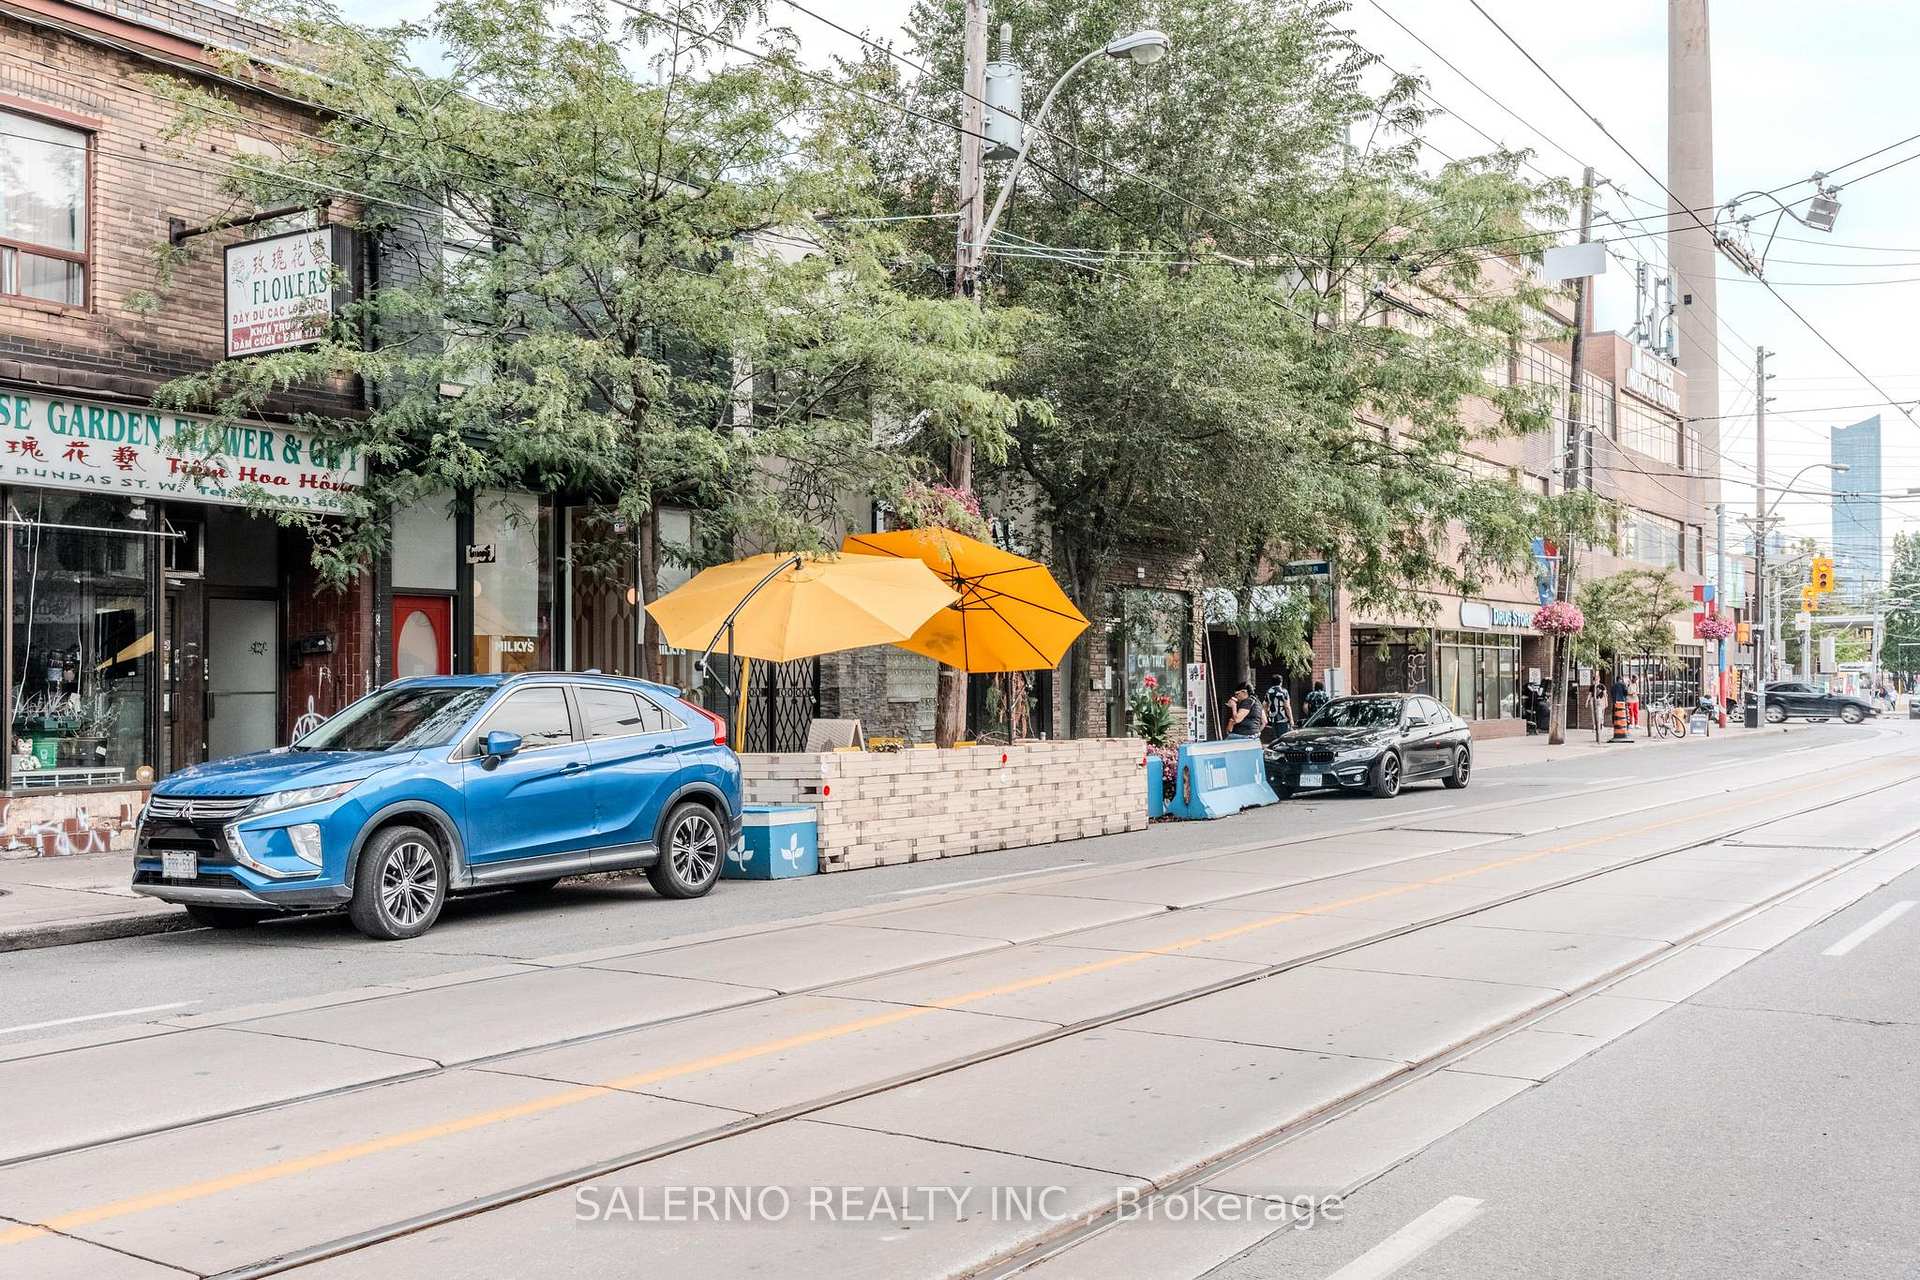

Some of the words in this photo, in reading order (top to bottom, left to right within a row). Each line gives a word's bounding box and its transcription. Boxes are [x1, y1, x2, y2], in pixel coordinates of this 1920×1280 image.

[253, 268, 327, 305] FLOWERS
[47, 400, 161, 446] GARDEN
[283, 433, 302, 464] &
[16, 467, 112, 485] DUNDAS
[121, 478, 150, 489] ST.
[239, 466, 290, 486] Hoa
